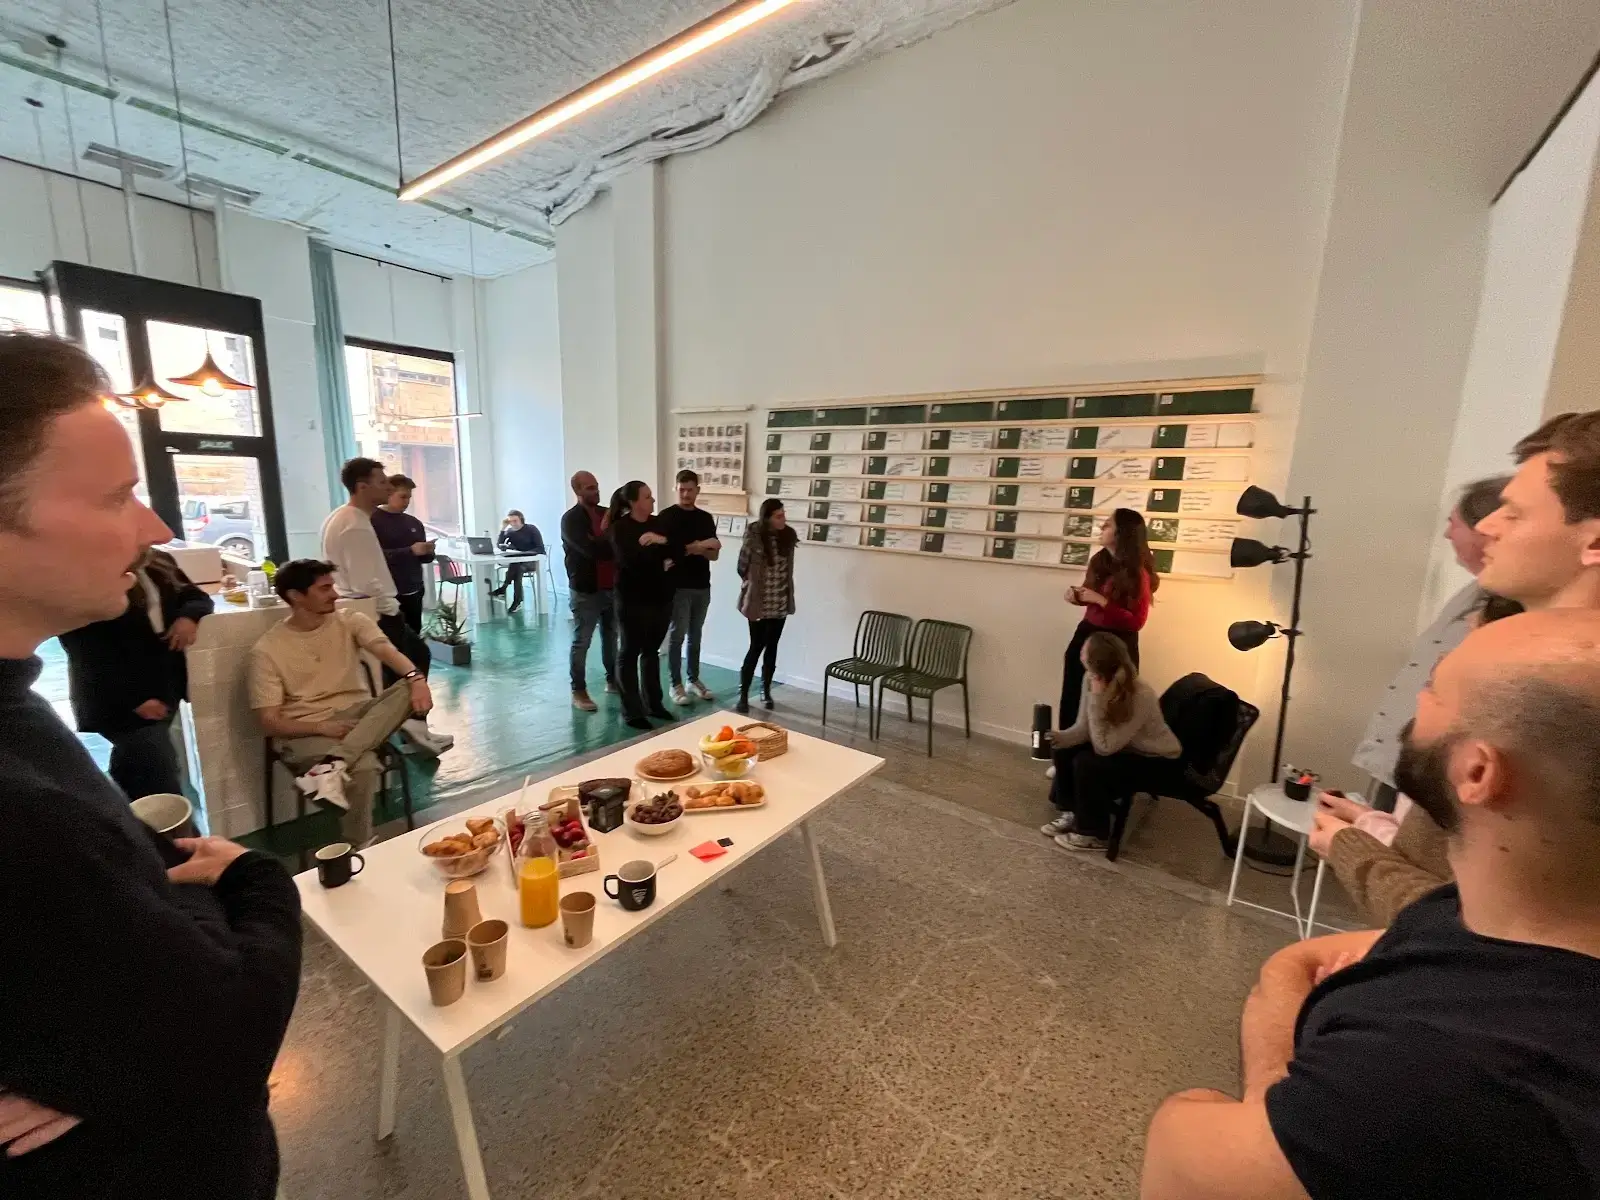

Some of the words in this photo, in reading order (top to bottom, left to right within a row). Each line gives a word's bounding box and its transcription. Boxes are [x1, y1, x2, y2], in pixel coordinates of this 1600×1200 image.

[1000, 430, 1008, 439] 31
[1074, 429, 1080, 438] 1
[1159, 427, 1167, 437] 2
[998, 459, 1005, 468] 7
[1157, 459, 1165, 469] 9
[1071, 488, 1080, 498] 15
[1152, 520, 1163, 530] 23
